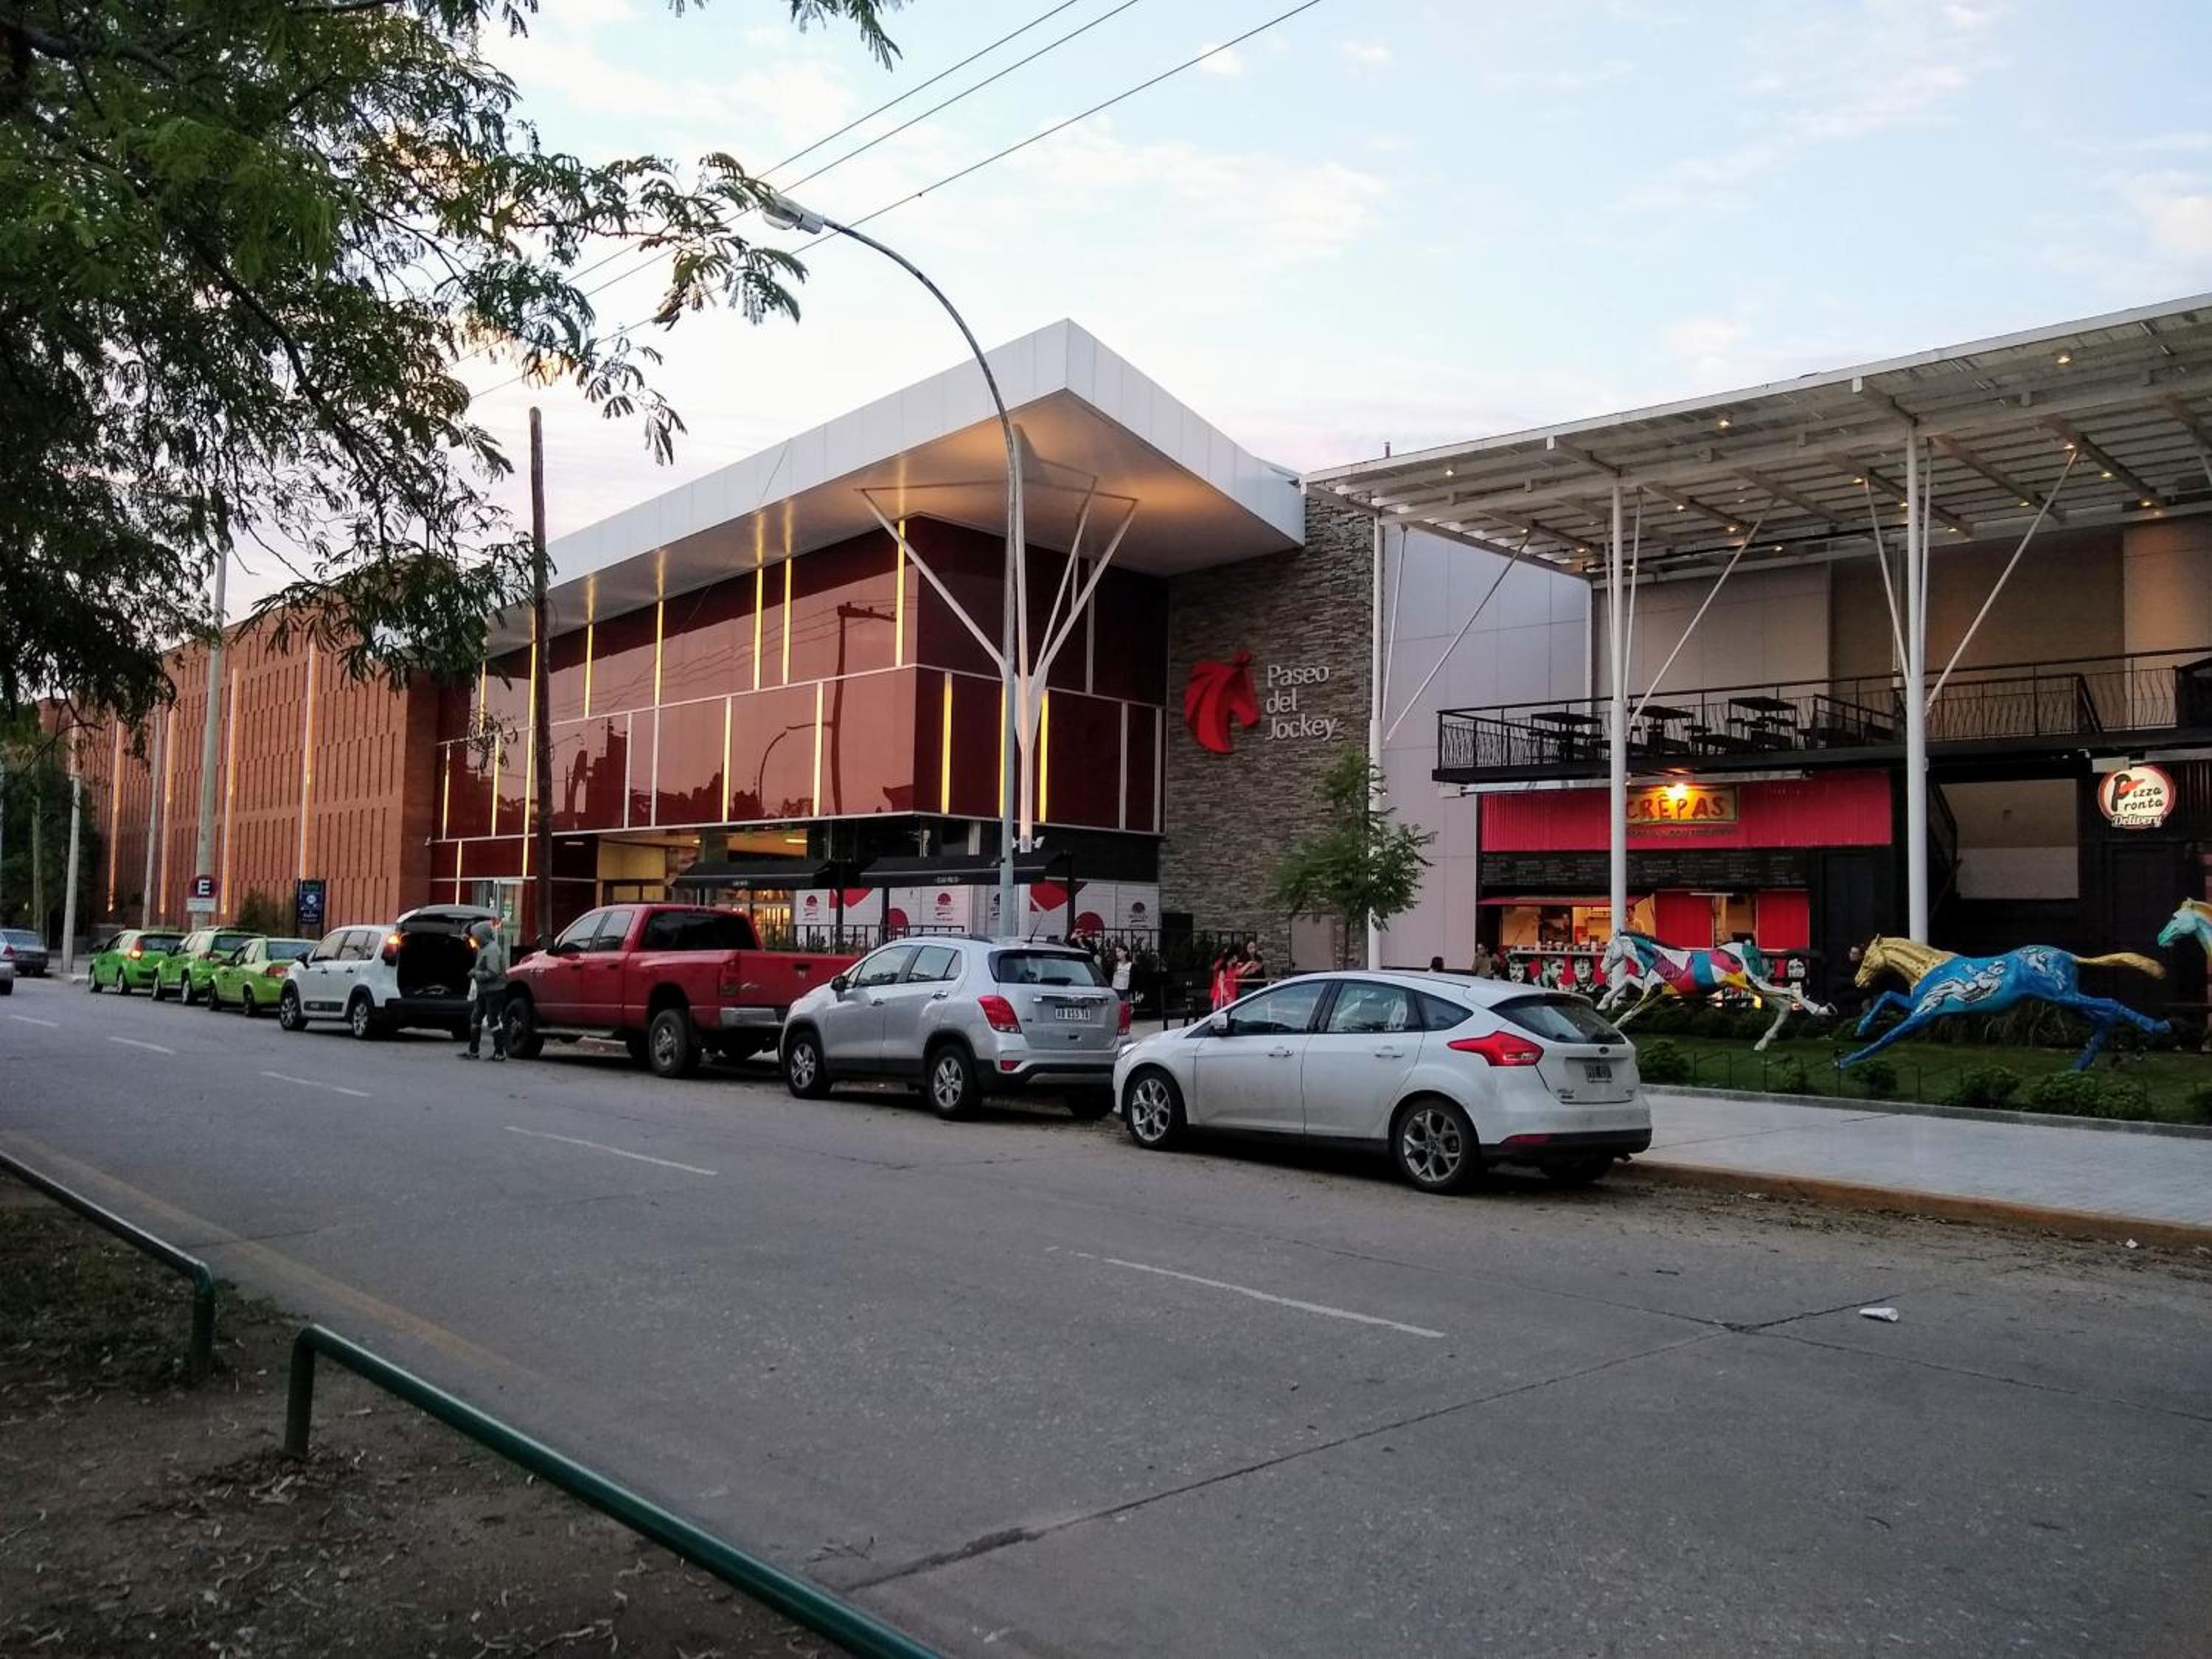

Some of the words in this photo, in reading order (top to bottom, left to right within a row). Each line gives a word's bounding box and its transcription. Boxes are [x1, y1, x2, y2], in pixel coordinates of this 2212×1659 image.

[1267, 664, 1330, 686] Paseo
[1266, 687, 1298, 714] del
[1265, 714, 1338, 741] Jockey
[2111, 773, 2163, 812] Pizza
[2112, 813, 2163, 827] Delivery
[197, 879, 211, 896] E
